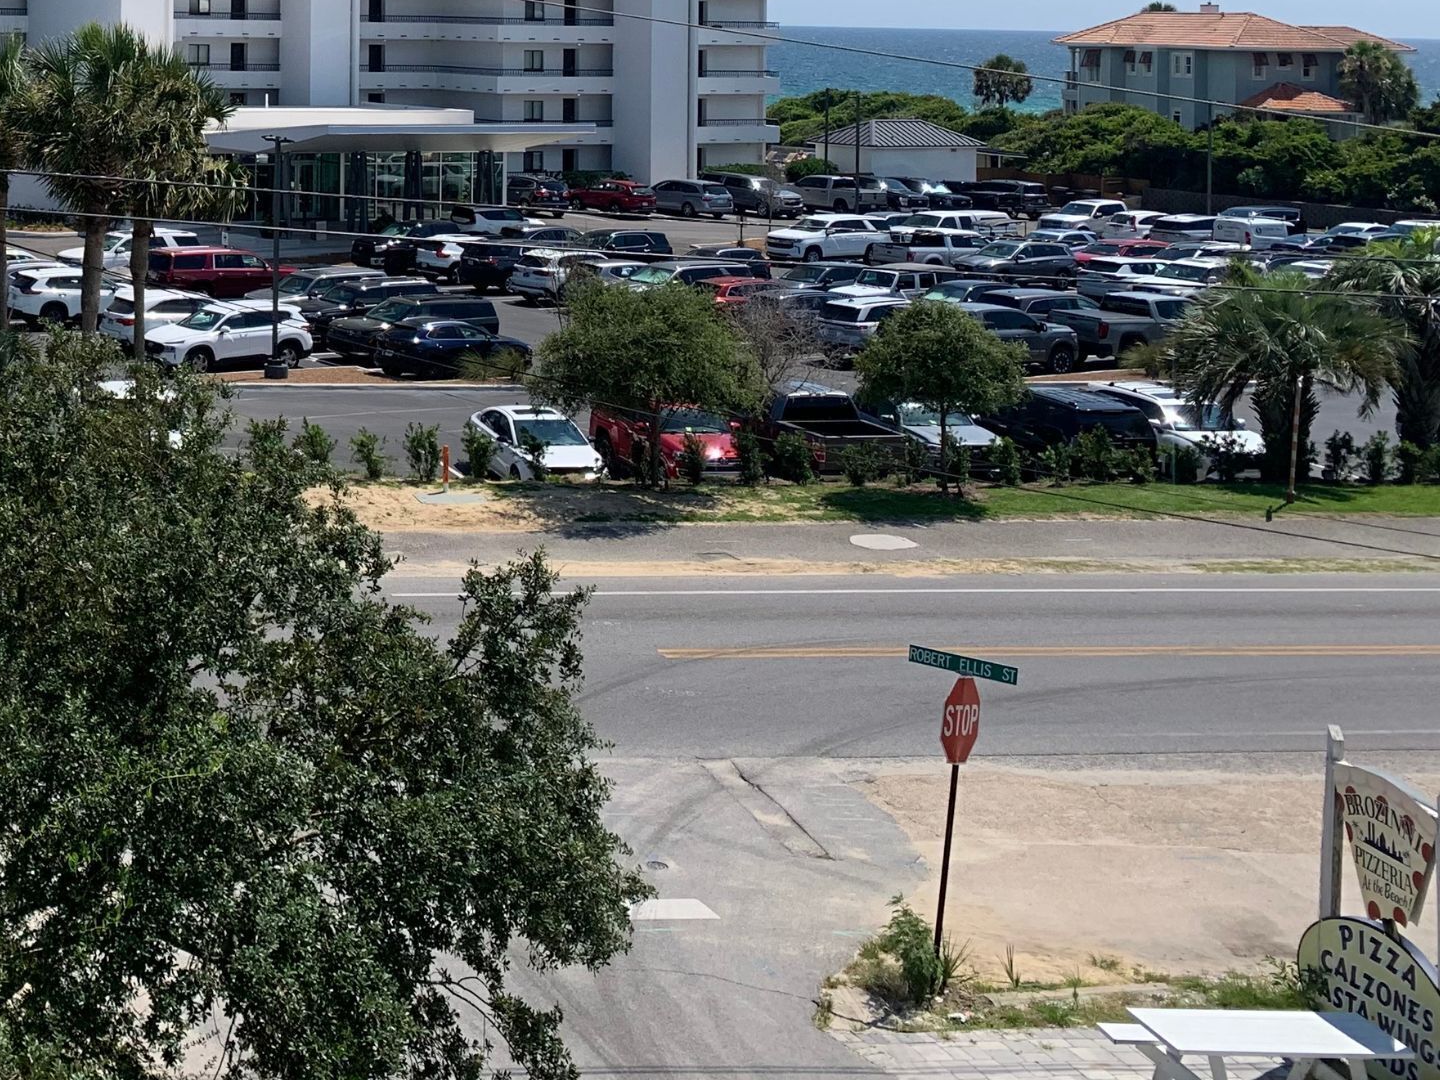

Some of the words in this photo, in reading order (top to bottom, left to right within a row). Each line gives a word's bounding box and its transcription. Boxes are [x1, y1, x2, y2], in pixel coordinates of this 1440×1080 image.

[909, 646, 953, 669] ROBERT
[959, 658, 992, 678] ELLIS
[1001, 667, 1017, 683] ST
[943, 704, 979, 738] STOP
[1354, 844, 1414, 896] PIZZERIA
[1362, 873, 1372, 891] At
[1372, 878, 1384, 897] the
[1384, 882, 1414, 911] Beach!
[1338, 924, 1416, 992] PIZZA
[1314, 974, 1369, 1021] ASTA
[1320, 949, 1434, 1032] CALZONES
